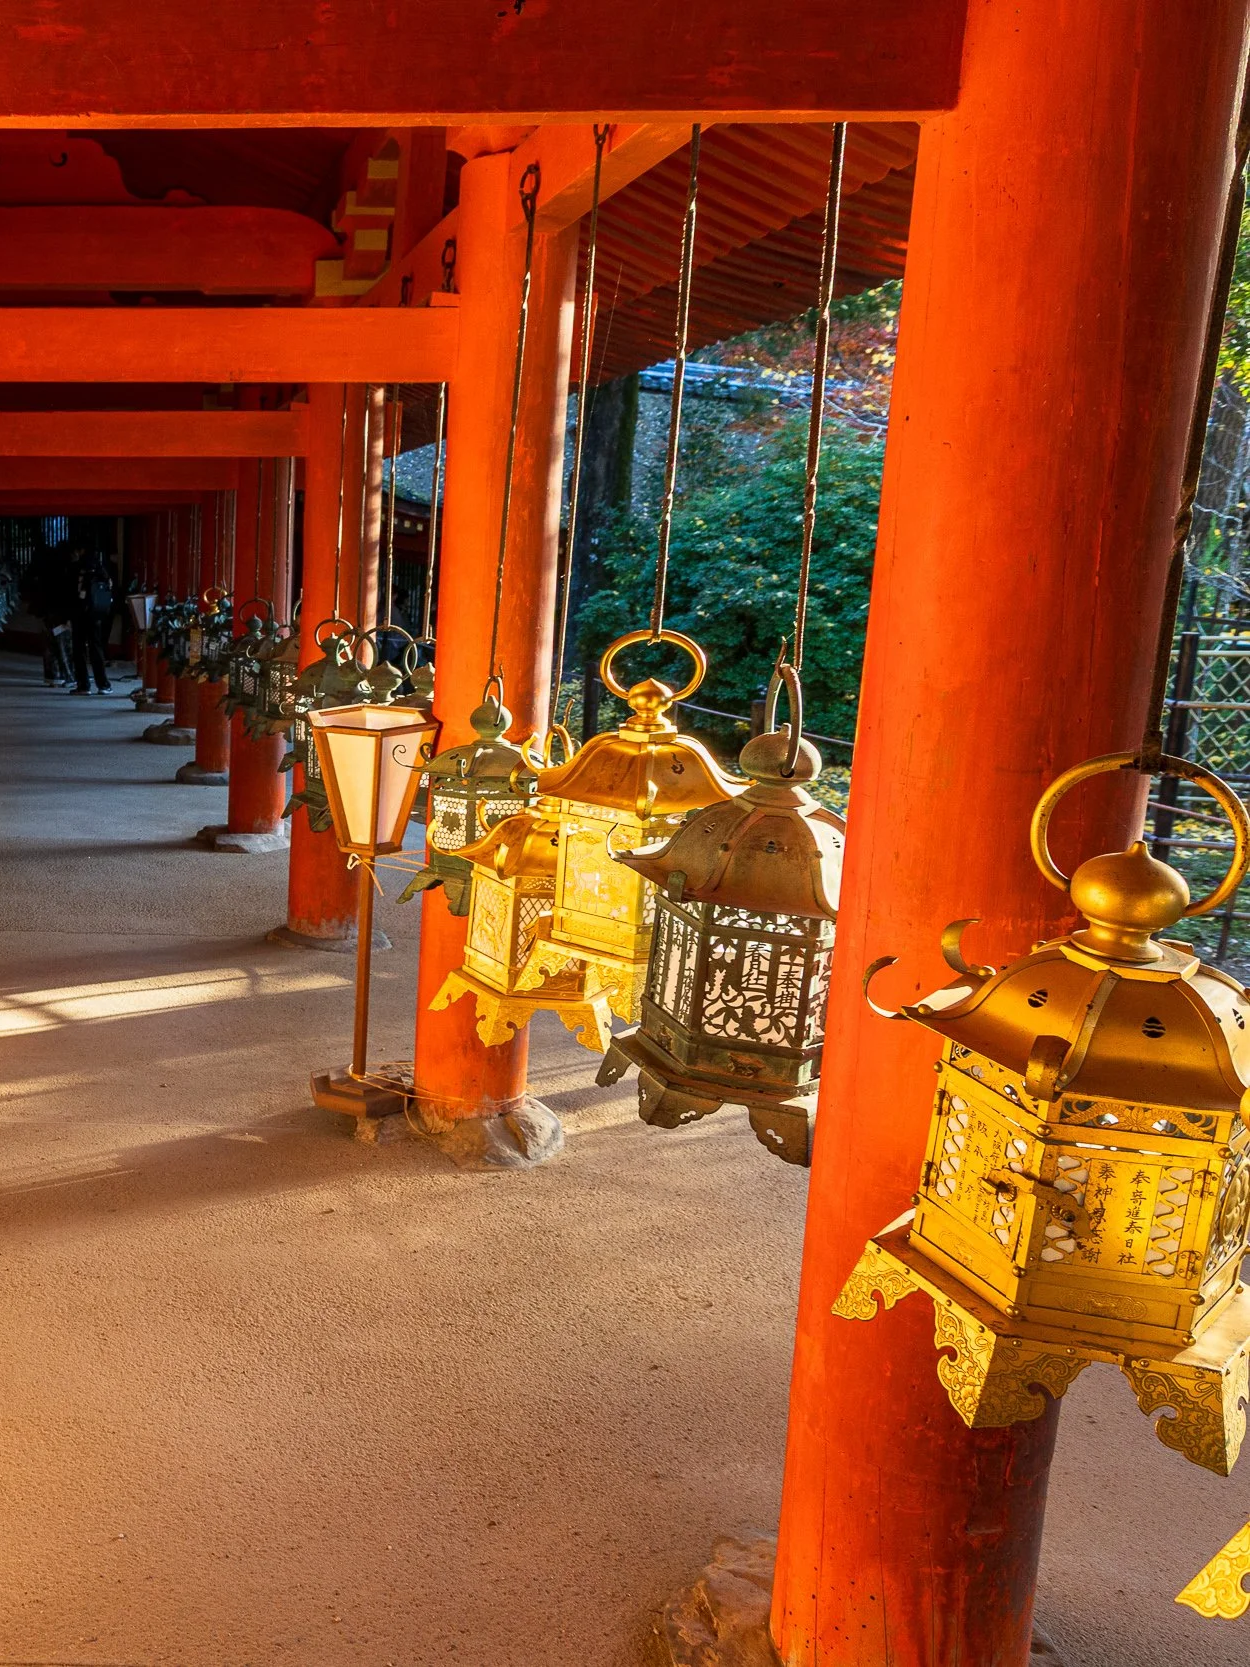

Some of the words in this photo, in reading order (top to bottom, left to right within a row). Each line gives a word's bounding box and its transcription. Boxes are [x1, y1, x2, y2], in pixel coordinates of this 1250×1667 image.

[1117, 1169, 1151, 1265] 奉寄進春日社
